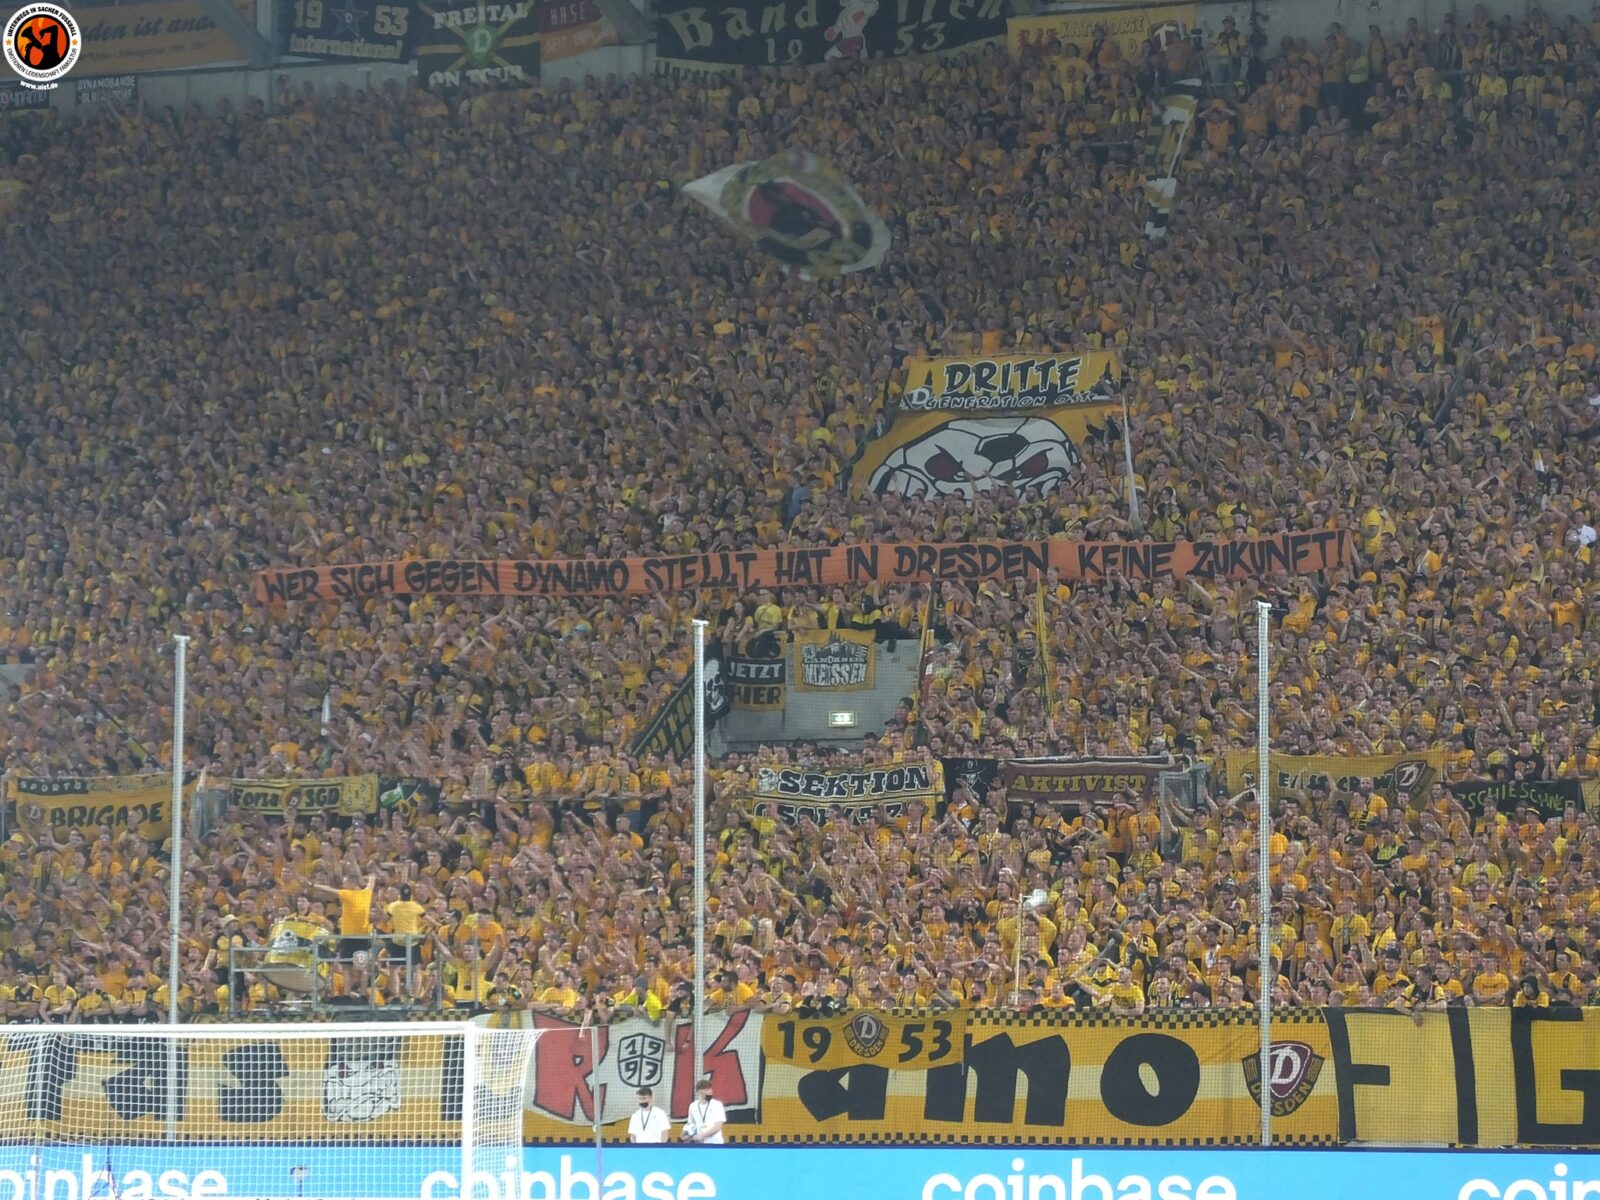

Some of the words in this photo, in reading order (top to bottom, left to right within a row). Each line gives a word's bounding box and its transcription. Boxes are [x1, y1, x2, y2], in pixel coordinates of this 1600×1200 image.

[374, 5, 409, 36] 53
[433, 2, 529, 29] FREITAL
[1060, 15, 1145, 39] KATGORIE
[943, 357, 1083, 394] DRITTE
[925, 394, 1046, 409] GENERATION
[262, 568, 323, 600] WER
[331, 564, 395, 597] SICH
[404, 560, 500, 593] GEGEN
[513, 559, 629, 593] DYNAMO
[775, 548, 831, 585] HAT
[849, 545, 880, 580] IN
[893, 543, 1049, 579] DRESDEN
[1078, 542, 1176, 577] KEINE
[1191, 529, 1346, 578] ZUKUNFT!
[729, 661, 782, 679] JETZT
[777, 764, 931, 799] SEKTION
[1011, 774, 1148, 793] AKTIVIST
[304, 787, 340, 806] SGD
[51, 801, 164, 828] BRIGADE
[777, 1020, 832, 1064] 19
[898, 1020, 952, 1064] 53
[849, 1037, 885, 1058] DRESDEN
[1250, 1081, 1312, 1117] DSDEN
[922, 1157, 1237, 1200] coinbase
